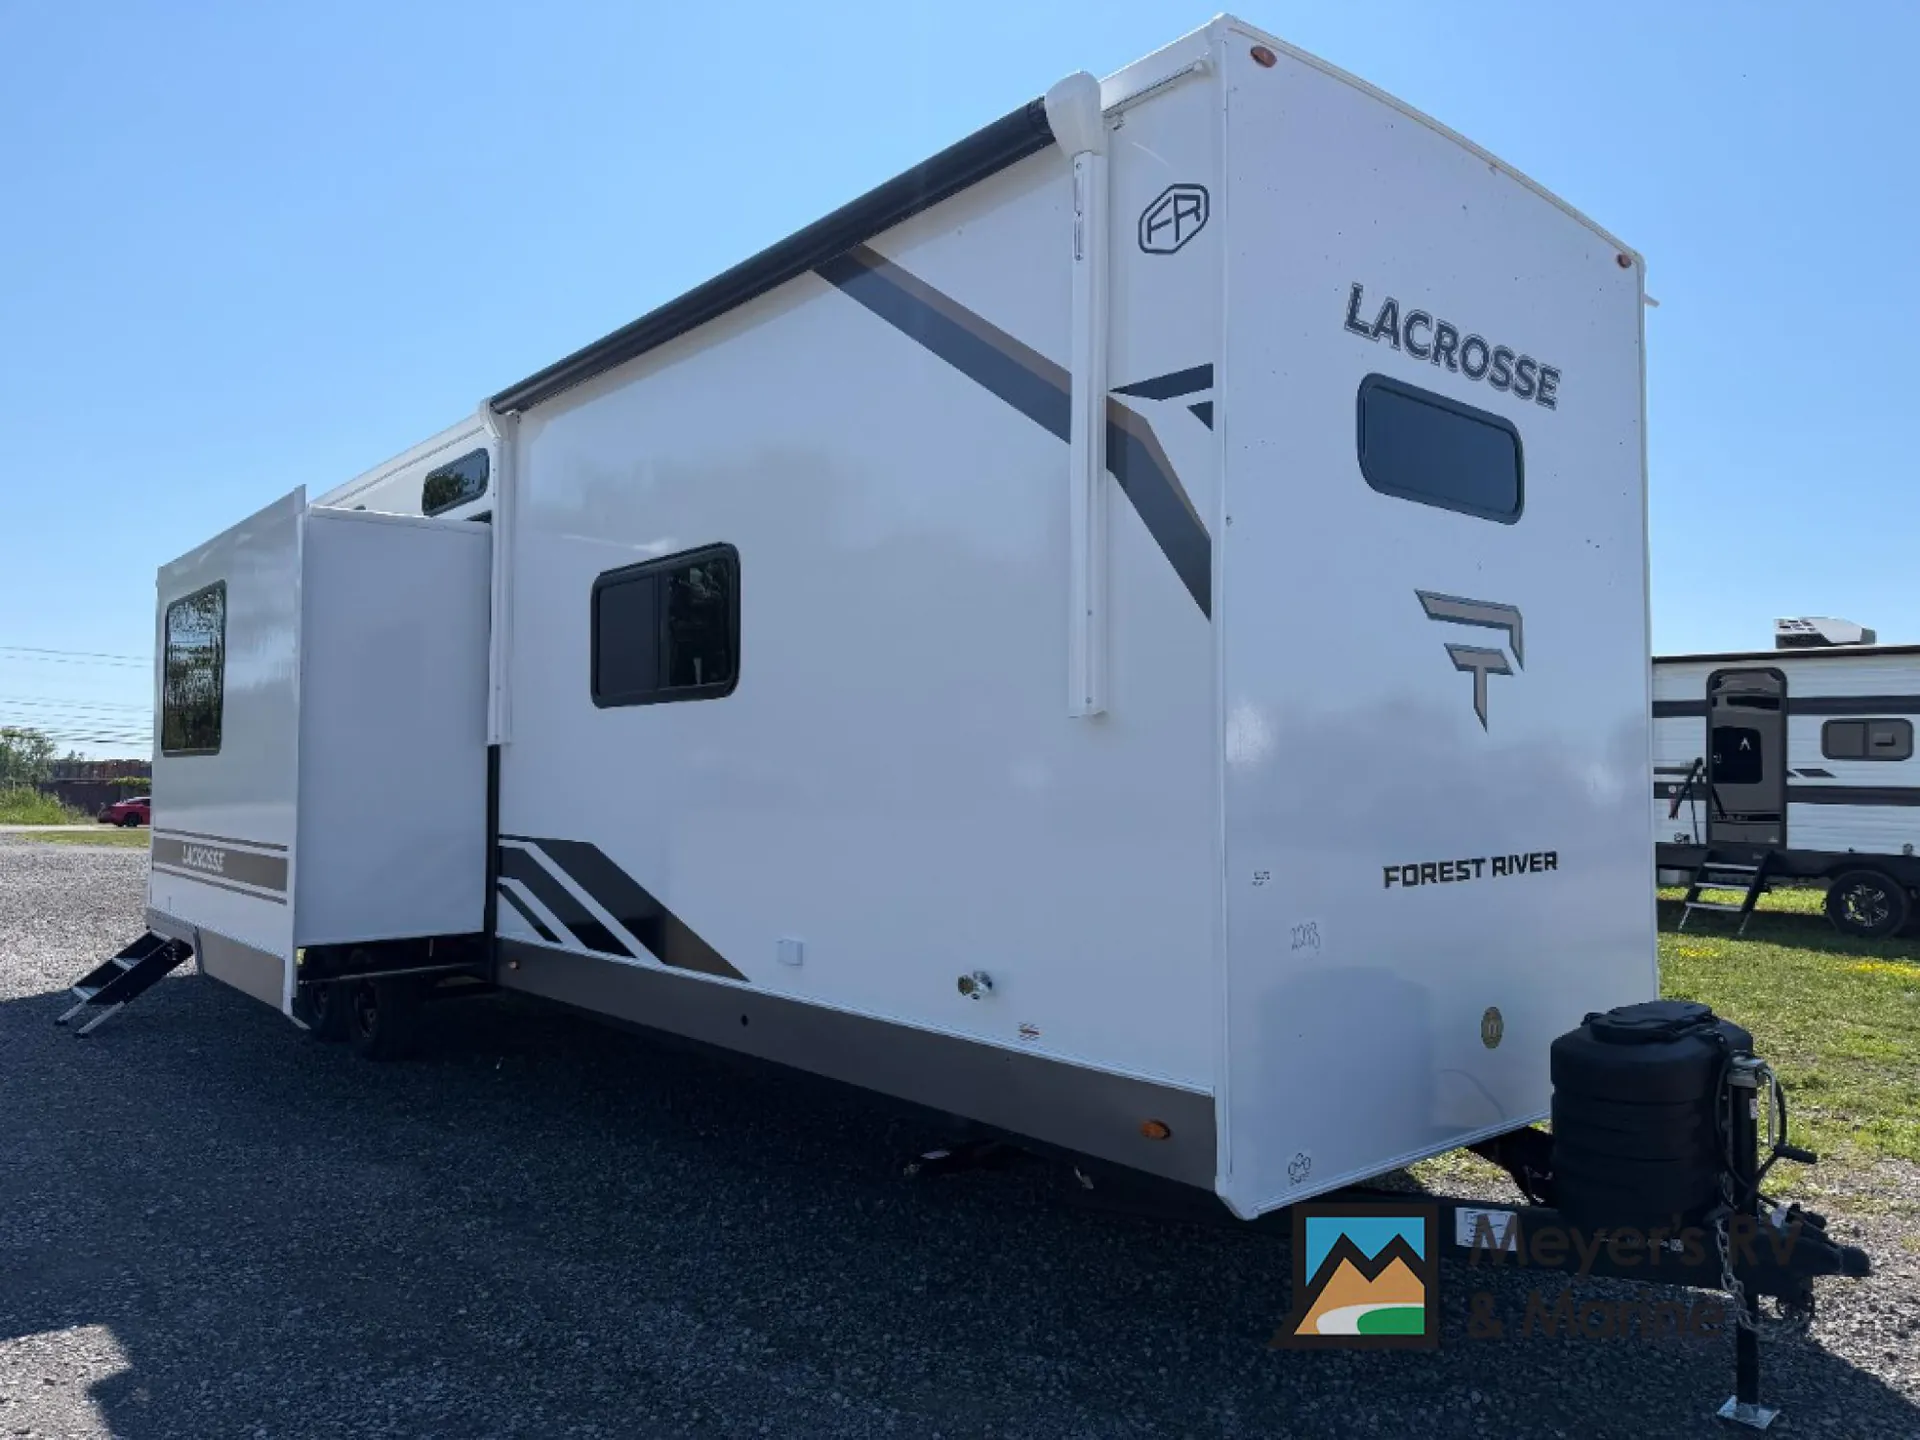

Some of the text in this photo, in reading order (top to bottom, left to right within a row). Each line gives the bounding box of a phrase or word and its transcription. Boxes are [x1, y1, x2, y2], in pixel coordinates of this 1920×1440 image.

[1344, 281, 1561, 411] LACROSSE
[181, 843, 226, 873] LACROSSE
[1383, 850, 1558, 889] FOREST RIVER
